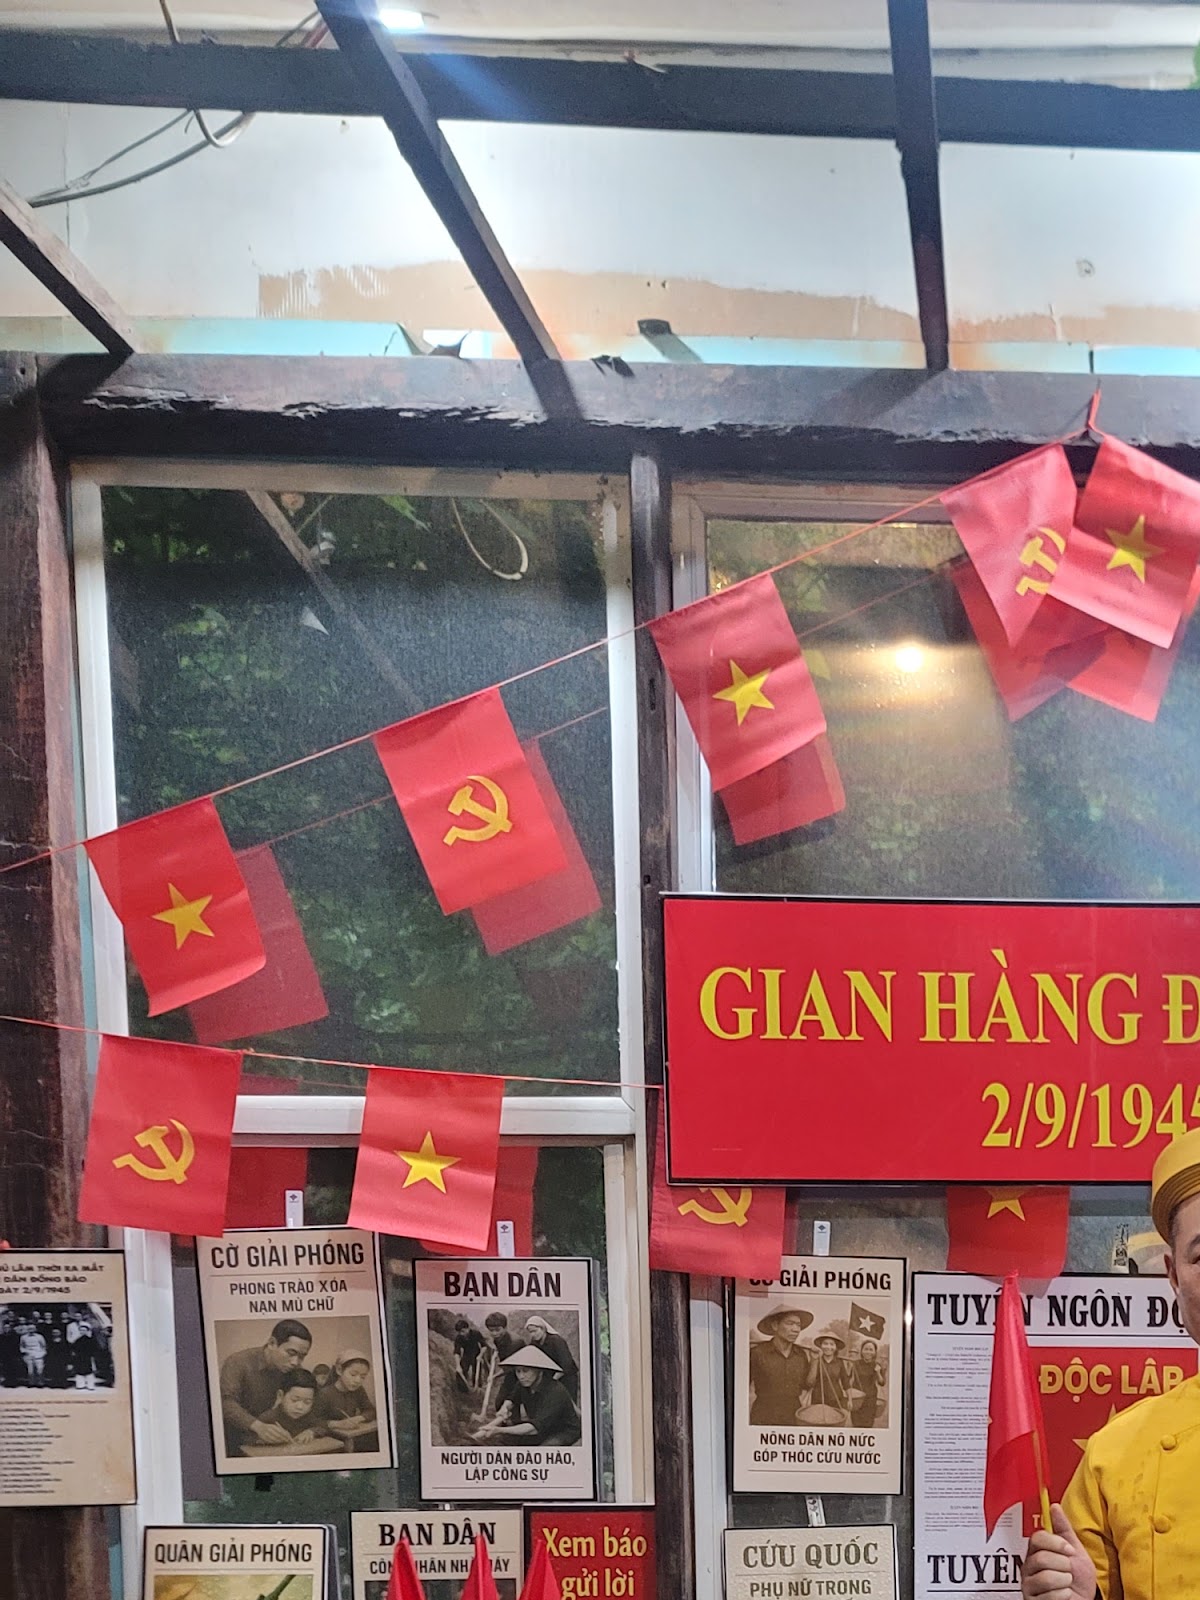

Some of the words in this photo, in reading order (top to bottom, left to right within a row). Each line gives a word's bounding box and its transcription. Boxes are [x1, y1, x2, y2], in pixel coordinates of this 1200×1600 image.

[700, 966, 897, 1042] GIAN
[918, 949, 1143, 1045] HÀNG
[211, 1243, 239, 1269] CỜ
[247, 1238, 287, 1267] GIẢI
[294, 1239, 365, 1267] PHÓNG
[230, 1282, 275, 1296] PHONG
[279, 1279, 315, 1295] TRÀO
[319, 1277, 348, 1293] XÓA
[444, 1271, 498, 1302] BẠN
[508, 1267, 562, 1297] DÂN
[780, 1264, 818, 1288] GIẢI
[825, 1267, 892, 1290] PHÓNG
[250, 1301, 277, 1316] NẠN
[282, 1297, 304, 1312] MÙ
[308, 1296, 334, 1312] CHỮ
[1047, 1289, 1132, 1327] NGÔN
[1038, 1357, 1112, 1403] ĐỘC
[760, 1431, 796, 1446] NÔNG
[799, 1432, 824, 1447] DÂN
[849, 1433, 875, 1447] NỨC
[441, 1451, 483, 1465] NGƯỜI
[486, 1451, 512, 1465] DÂN
[516, 1451, 542, 1465] ĐÀO
[546, 1451, 576, 1467] HÀO,
[753, 1449, 778, 1463] GÓP
[781, 1449, 814, 1463] THÓC
[817, 1450, 842, 1464] CỨU
[846, 1450, 881, 1465] NƯỚC
[465, 1467, 490, 1484] LẬP
[493, 1467, 528, 1482] CÔNG
[531, 1468, 549, 1482] SỰ
[442, 1517, 496, 1546] DÂN
[542, 1527, 596, 1557] Xem
[603, 1526, 648, 1557] báo
[154, 1540, 202, 1564] QUÂN
[209, 1537, 244, 1563] GIẢI
[250, 1539, 312, 1563] PHÓNG
[743, 1539, 796, 1569] CỨU
[804, 1536, 879, 1568] QUỐC
[604, 1567, 635, 1597] lời
[750, 1582, 784, 1599] PHỤ
[788, 1580, 812, 1597] NỮ
[816, 1579, 871, 1596] TRONG
